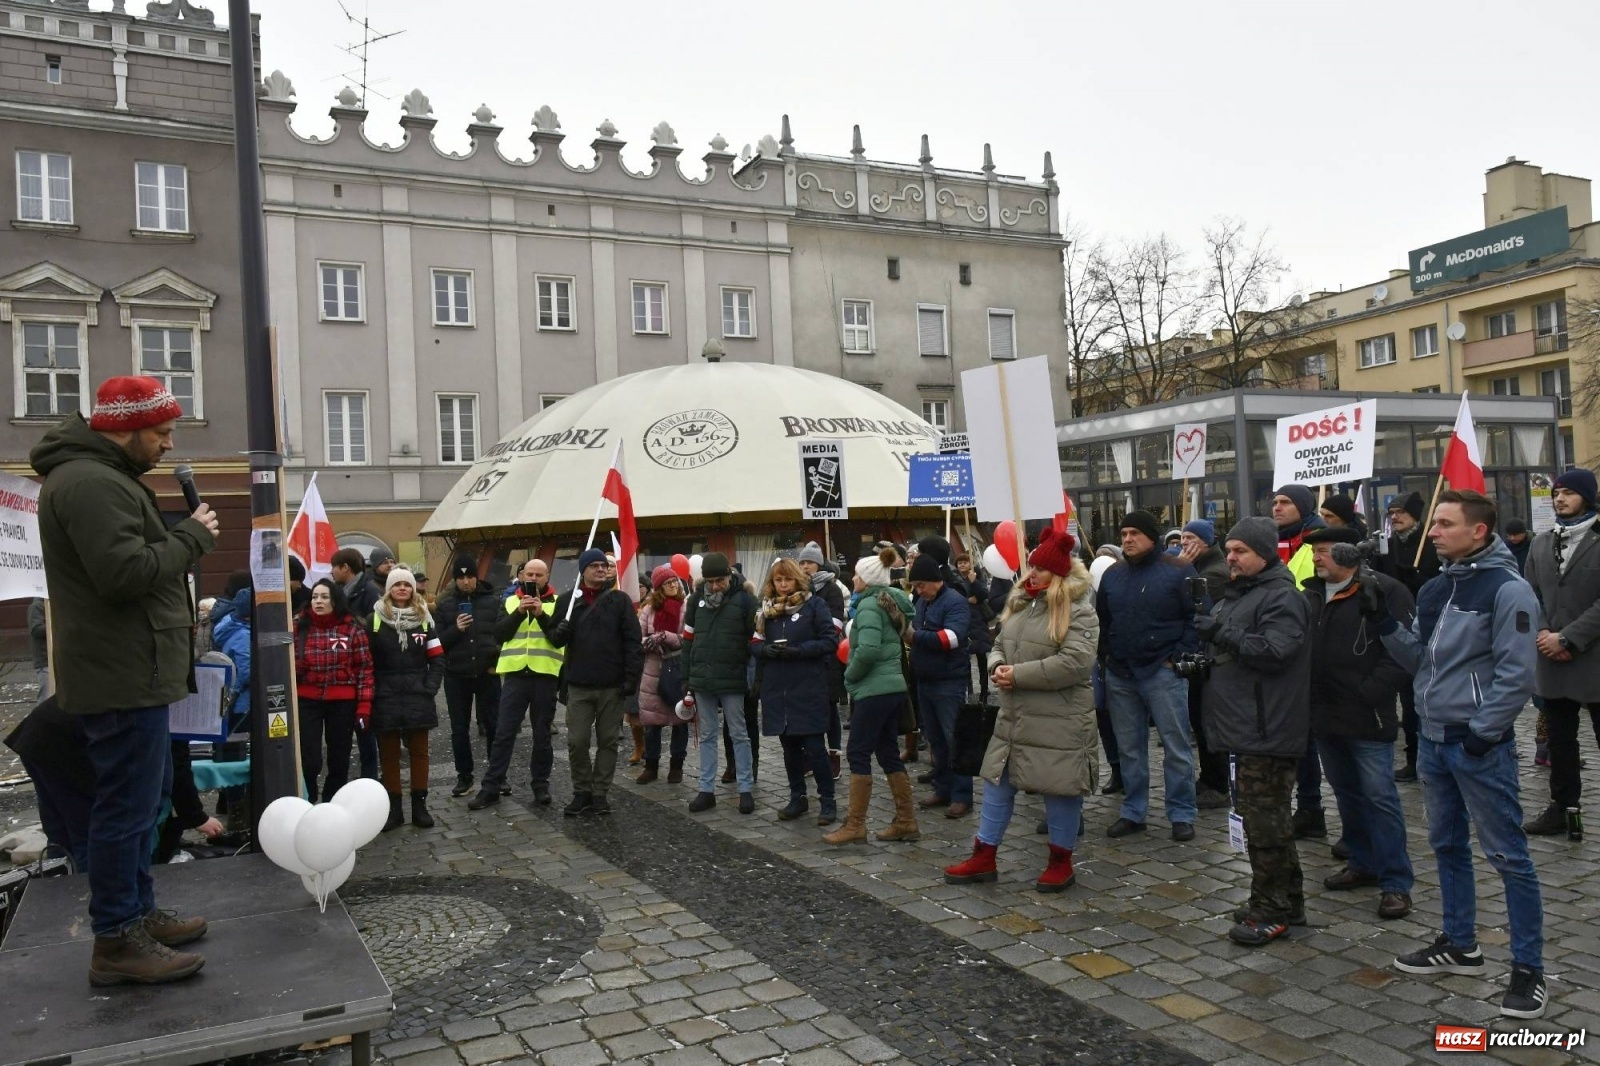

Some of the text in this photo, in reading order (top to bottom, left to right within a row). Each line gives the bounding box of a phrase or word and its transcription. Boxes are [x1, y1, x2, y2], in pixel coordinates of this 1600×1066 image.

[1446, 236, 1524, 266] McDonald's
[1415, 271, 1442, 283] 300 m
[651, 411, 733, 435] BROWAR ZAMKOWY
[779, 415, 882, 437] BROWAR
[1289, 412, 1348, 443] DOŚĆ
[695, 430, 730, 446] 1567
[939, 440, 969, 449] ZDROWI
[941, 434, 969, 443] SŁUŻB
[656, 445, 723, 467] RACIBÓRZ
[802, 444, 838, 454] MEDIA
[1294, 439, 1354, 459] ODWOŁAĆ
[1307, 455, 1338, 468] STAN
[1294, 463, 1351, 481] PANDEMII
